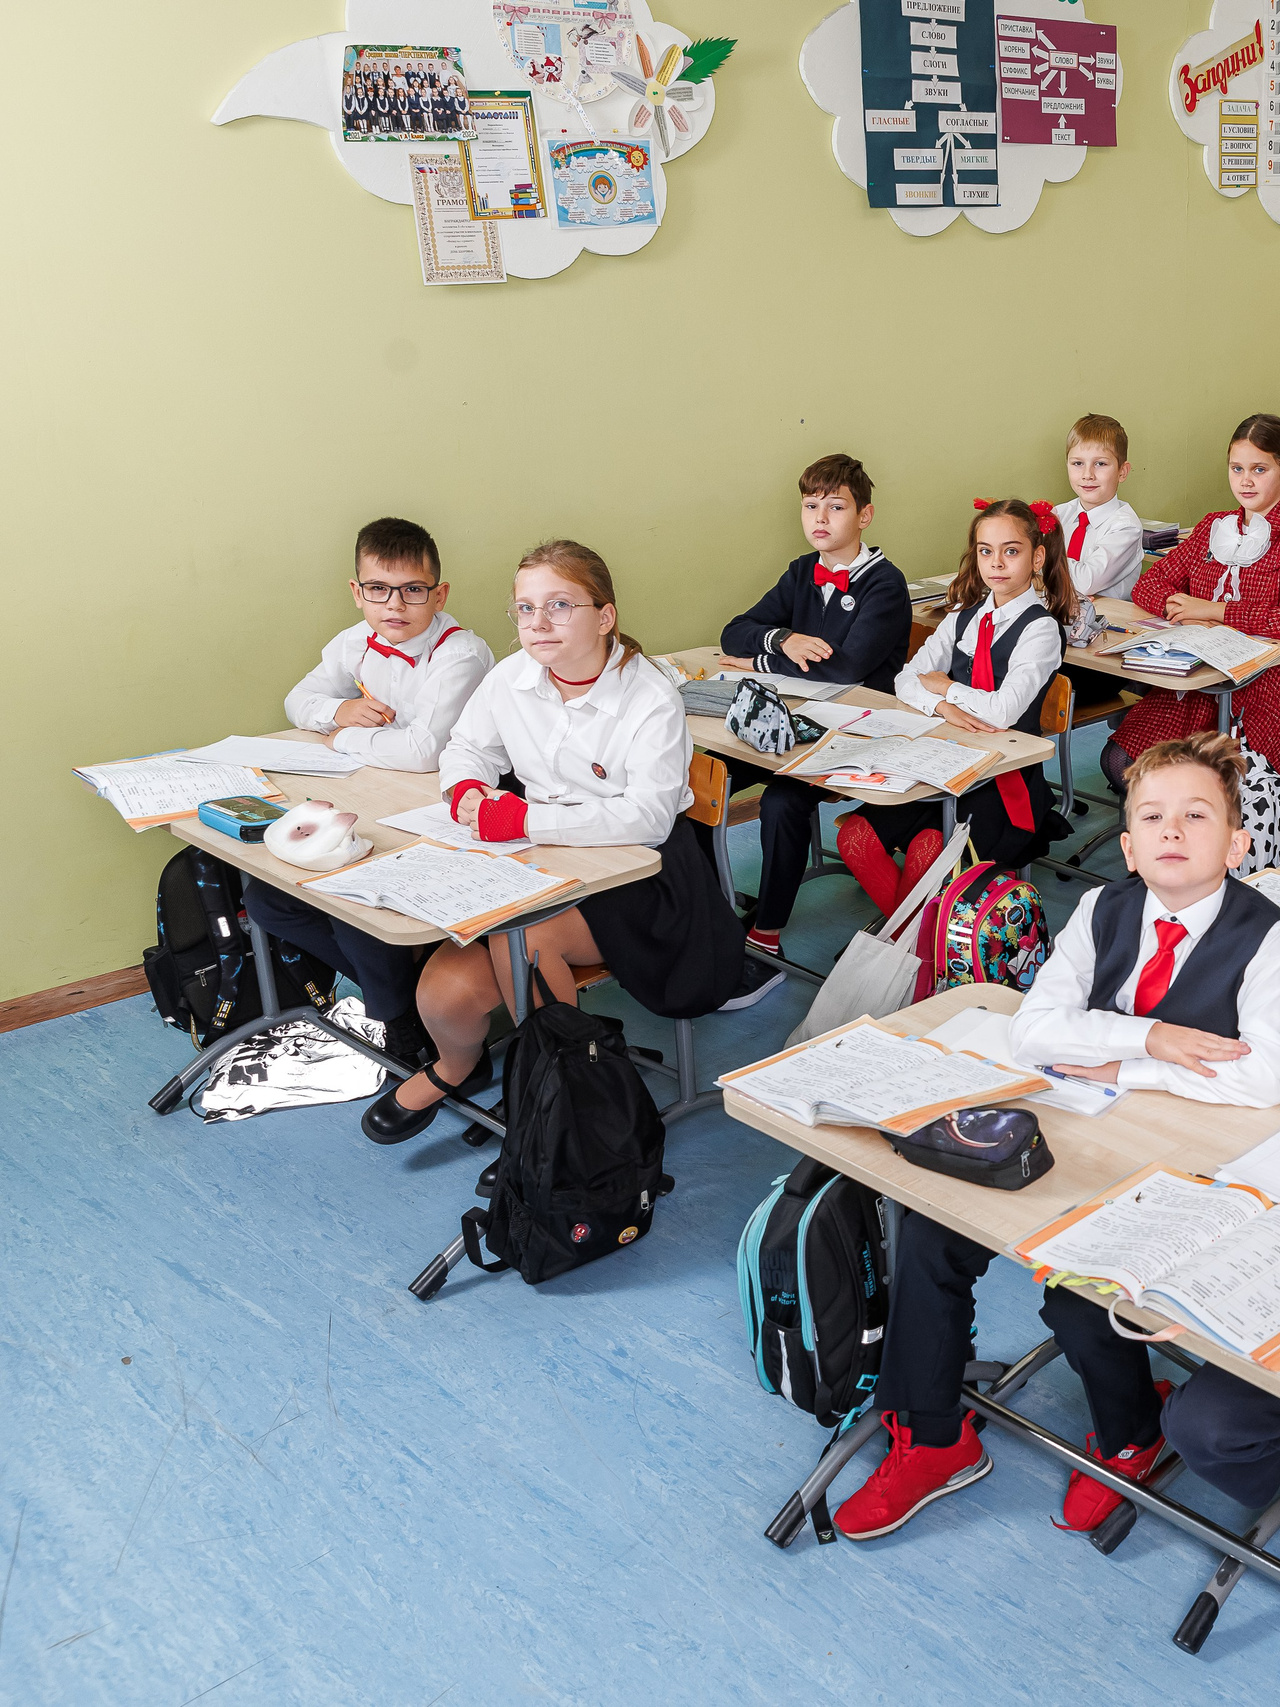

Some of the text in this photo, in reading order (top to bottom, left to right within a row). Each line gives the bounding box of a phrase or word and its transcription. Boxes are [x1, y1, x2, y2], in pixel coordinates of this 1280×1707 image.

[906, 0, 960, 14] ПРЕДЛОЖЕНИЕ
[1271, 0, 1274, 9] 1
[1000, 23, 1033, 34] ПРИСТАВКА
[1270, 20, 1275, 30] 2
[922, 30, 946, 41] СЛОВО
[1004, 44, 1026, 54] КОРЕНЬ
[1271, 40, 1275, 50] 3
[923, 59, 947, 69] СЛОГИ
[1054, 56, 1074, 65] СЛОВО
[1097, 57, 1114, 66] ЗВУКИ
[1003, 66, 1028, 76] СУФФИКС
[1270, 61, 1275, 71] 4
[1097, 77, 1114, 86] БУКВЫ
[1270, 80, 1274, 90] 5
[924, 87, 948, 97] ЗВУКИ
[1003, 87, 1036, 97] ОКОНЧАНИЕ
[1043, 102, 1084, 111] ПРЕДЛОЖЕНИЕ
[1227, 104, 1251, 113] ЗАДАЧА
[1270, 100, 1274, 111] 6
[872, 117, 910, 126] ГЛАСНЫЕ
[946, 118, 989, 128] СОГЛАСНЫЕ
[1269, 120, 1274, 131] 7
[1055, 133, 1071, 141] ТЕКСТ
[1268, 141, 1273, 150] 8
[901, 155, 937, 164] ТВЕРДЫЕ
[960, 155, 989, 164] МЯГКИЕ
[1268, 160, 1272, 170] 9
[904, 190, 937, 199] ЗВОНКИЕ
[963, 190, 990, 199] ГЛУХИЕ
[761, 1269, 795, 1291] NOW
